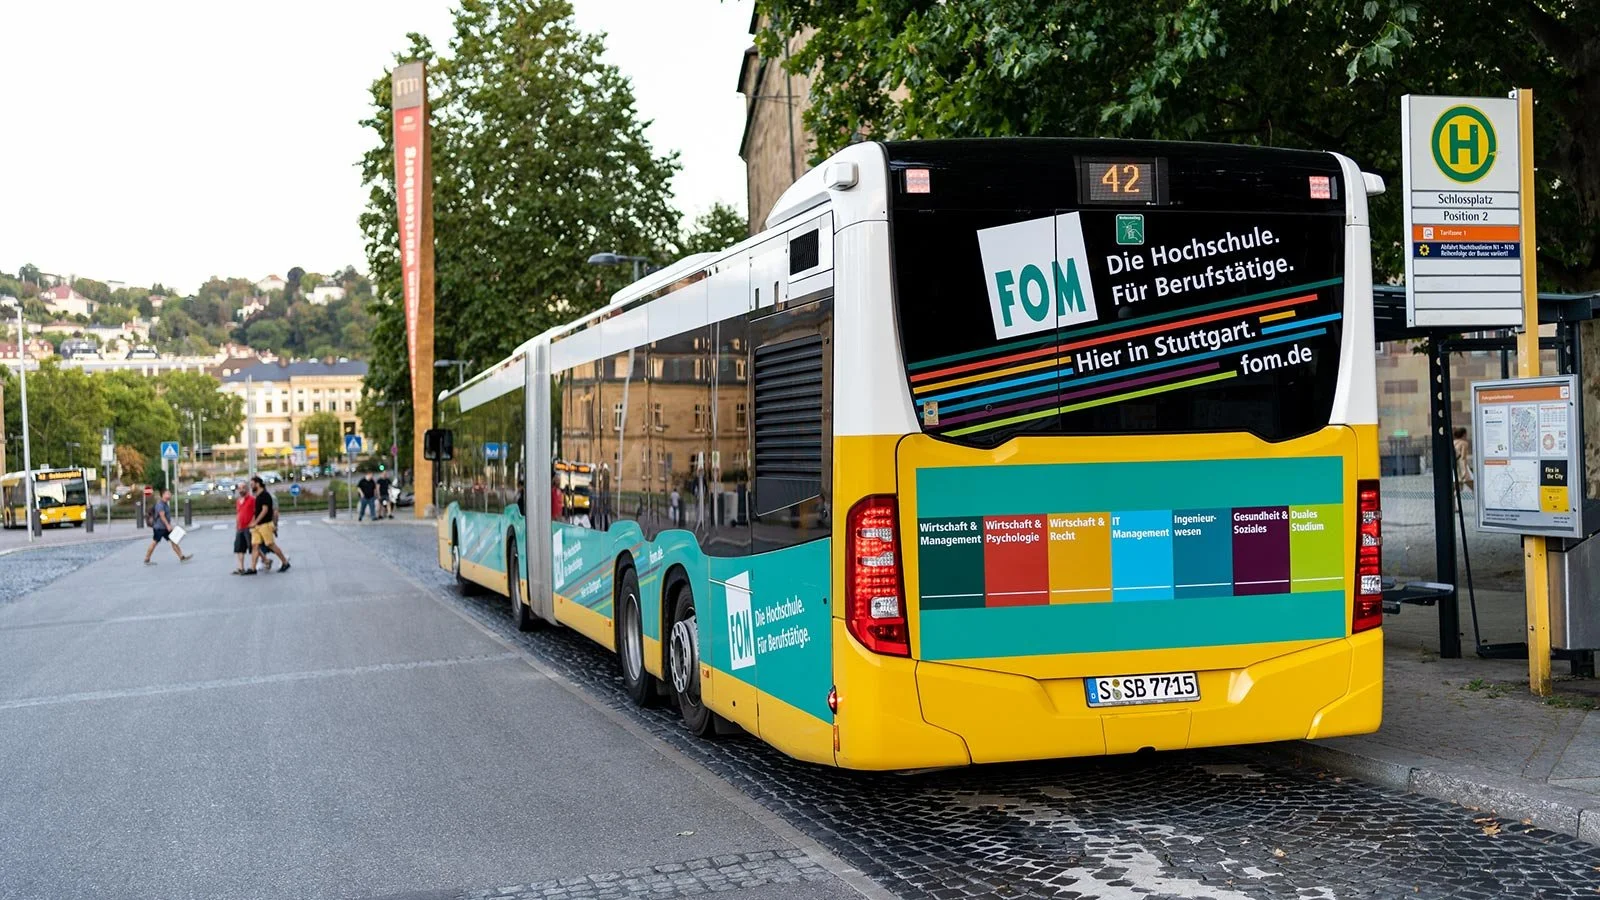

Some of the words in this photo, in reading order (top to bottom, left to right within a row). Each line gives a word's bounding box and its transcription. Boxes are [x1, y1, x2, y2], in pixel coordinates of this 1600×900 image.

[1449, 124, 1479, 165] H
[1102, 164, 1140, 193] 42
[1438, 193, 1493, 207] Schlossplatz
[1443, 210, 1480, 221] Position
[1482, 211, 1489, 221] 2
[1106, 251, 1145, 276] Die
[1151, 226, 1280, 267] Hochschule.
[1440, 250, 1467, 258] Reihenfolge
[1112, 282, 1148, 306] Für
[1155, 257, 1294, 297] Berufstätige.
[995, 257, 1086, 327] FOM
[1076, 349, 1122, 373] Hier
[1127, 341, 1149, 363] in
[1154, 320, 1256, 357] Stuttgart.
[1240, 343, 1313, 375] fom.de
[1174, 514, 1217, 526] Ingenieur-
[1233, 511, 1280, 522] Gesundheit
[1281, 511, 1289, 520] &
[1291, 509, 1318, 519] Duales
[919, 522, 968, 533] Wirtschaft
[970, 521, 978, 531] &
[985, 518, 1033, 530] Wirtschaft
[1034, 519, 1042, 528] &
[1049, 517, 1096, 528] Wirtschaft
[1097, 517, 1105, 526] &
[1112, 516, 1121, 526] IT
[1291, 522, 1325, 532] Studium
[1112, 528, 1170, 540] Management
[1174, 527, 1202, 537] wesen
[1233, 524, 1267, 535] Soziales
[920, 535, 982, 546] Management
[986, 532, 1040, 544] Psychologie
[1050, 531, 1076, 541] Recht
[754, 608, 766, 628] Die
[765, 594, 805, 624] Hochschule.
[729, 608, 753, 661] FOM
[757, 636, 767, 655] Für
[767, 624, 811, 649] Berufstätige.
[1099, 680, 1111, 700] S
[1123, 678, 1147, 698] SB
[1150, 675, 1195, 697] 7715
